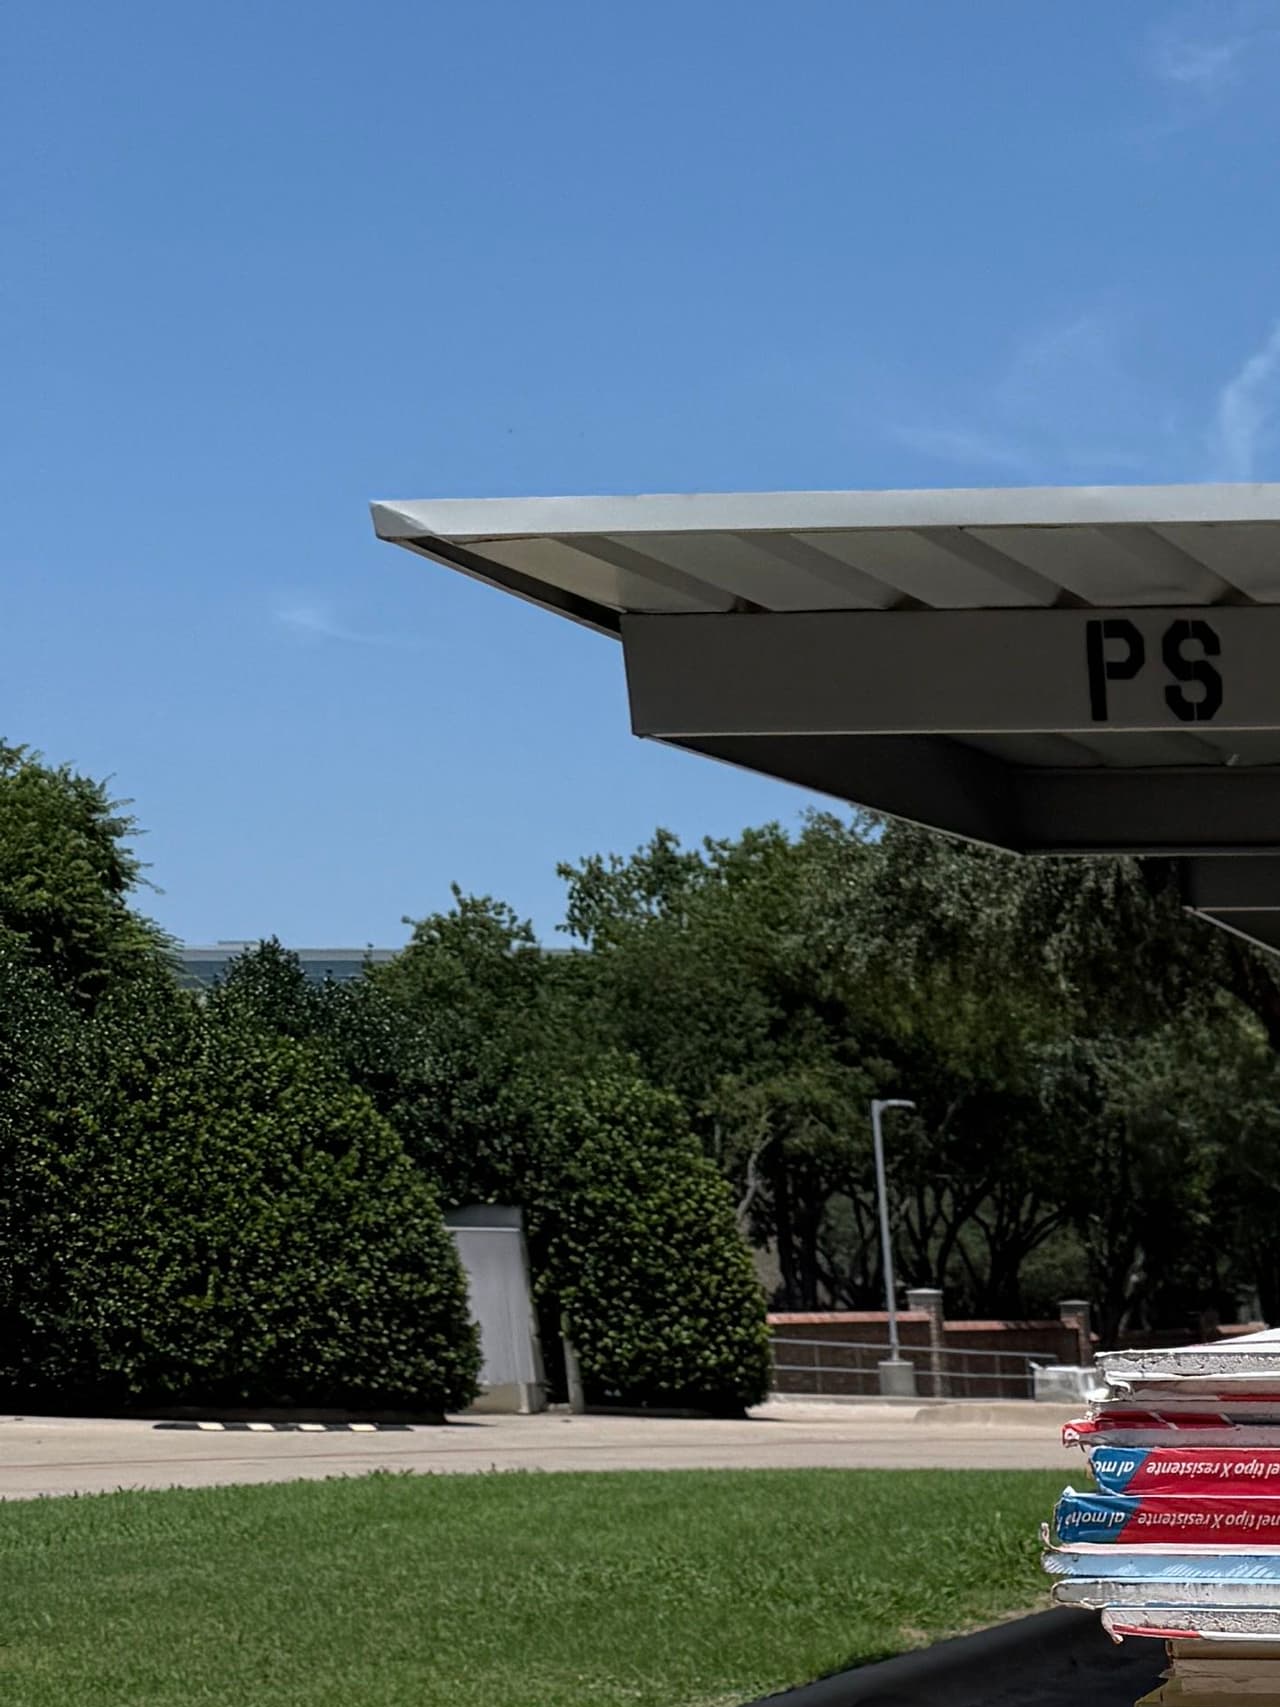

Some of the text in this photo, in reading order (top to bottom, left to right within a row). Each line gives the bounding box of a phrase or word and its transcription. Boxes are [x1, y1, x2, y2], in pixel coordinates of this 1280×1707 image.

[1086, 619, 1223, 721] PS
[1117, 1461, 1134, 1476] al
[1146, 1462, 1220, 1478] resistente
[1220, 1463, 1233, 1477] X
[1234, 1459, 1265, 1478] tipo
[1108, 1512, 1125, 1527] al
[1137, 1513, 1211, 1529] resistente
[1210, 1514, 1224, 1529] X
[1225, 1510, 1255, 1529] tipo
